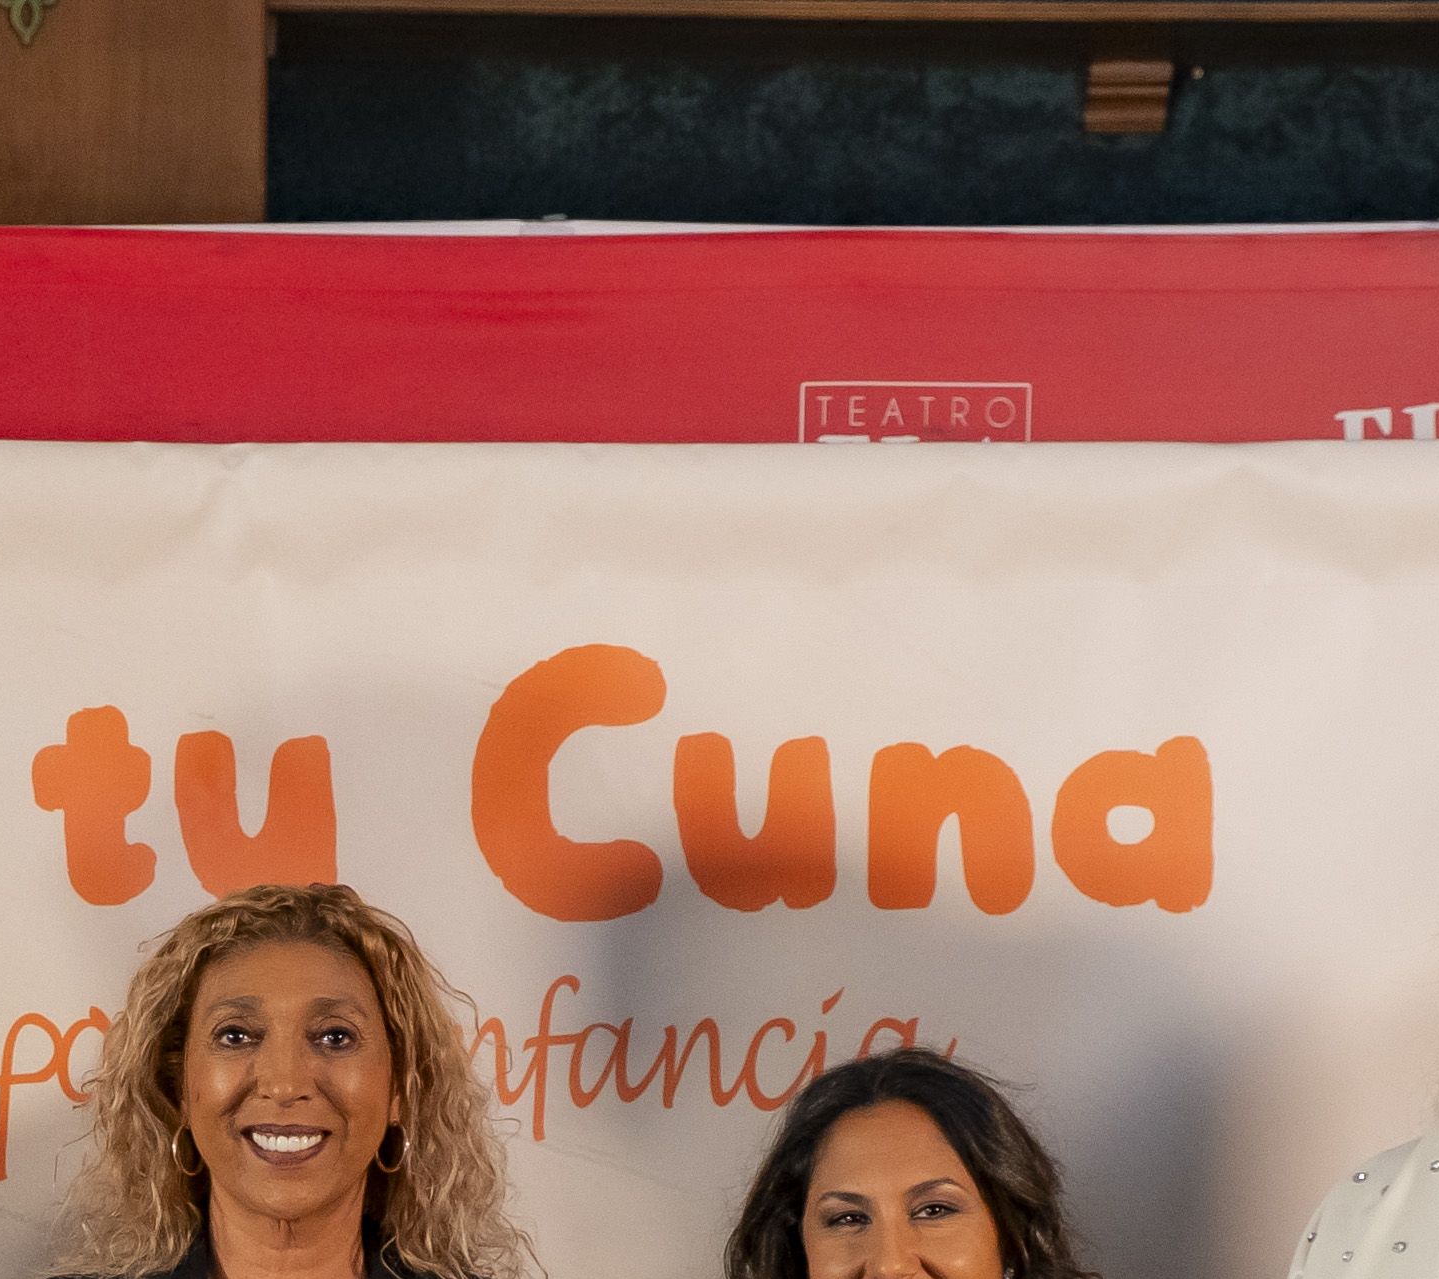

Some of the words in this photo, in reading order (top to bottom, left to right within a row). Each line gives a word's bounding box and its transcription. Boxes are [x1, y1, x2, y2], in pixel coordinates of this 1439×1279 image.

[816, 396, 1017, 429] TEATRO
[31, 704, 339, 908] tu
[470, 642, 1215, 923] Cuna
